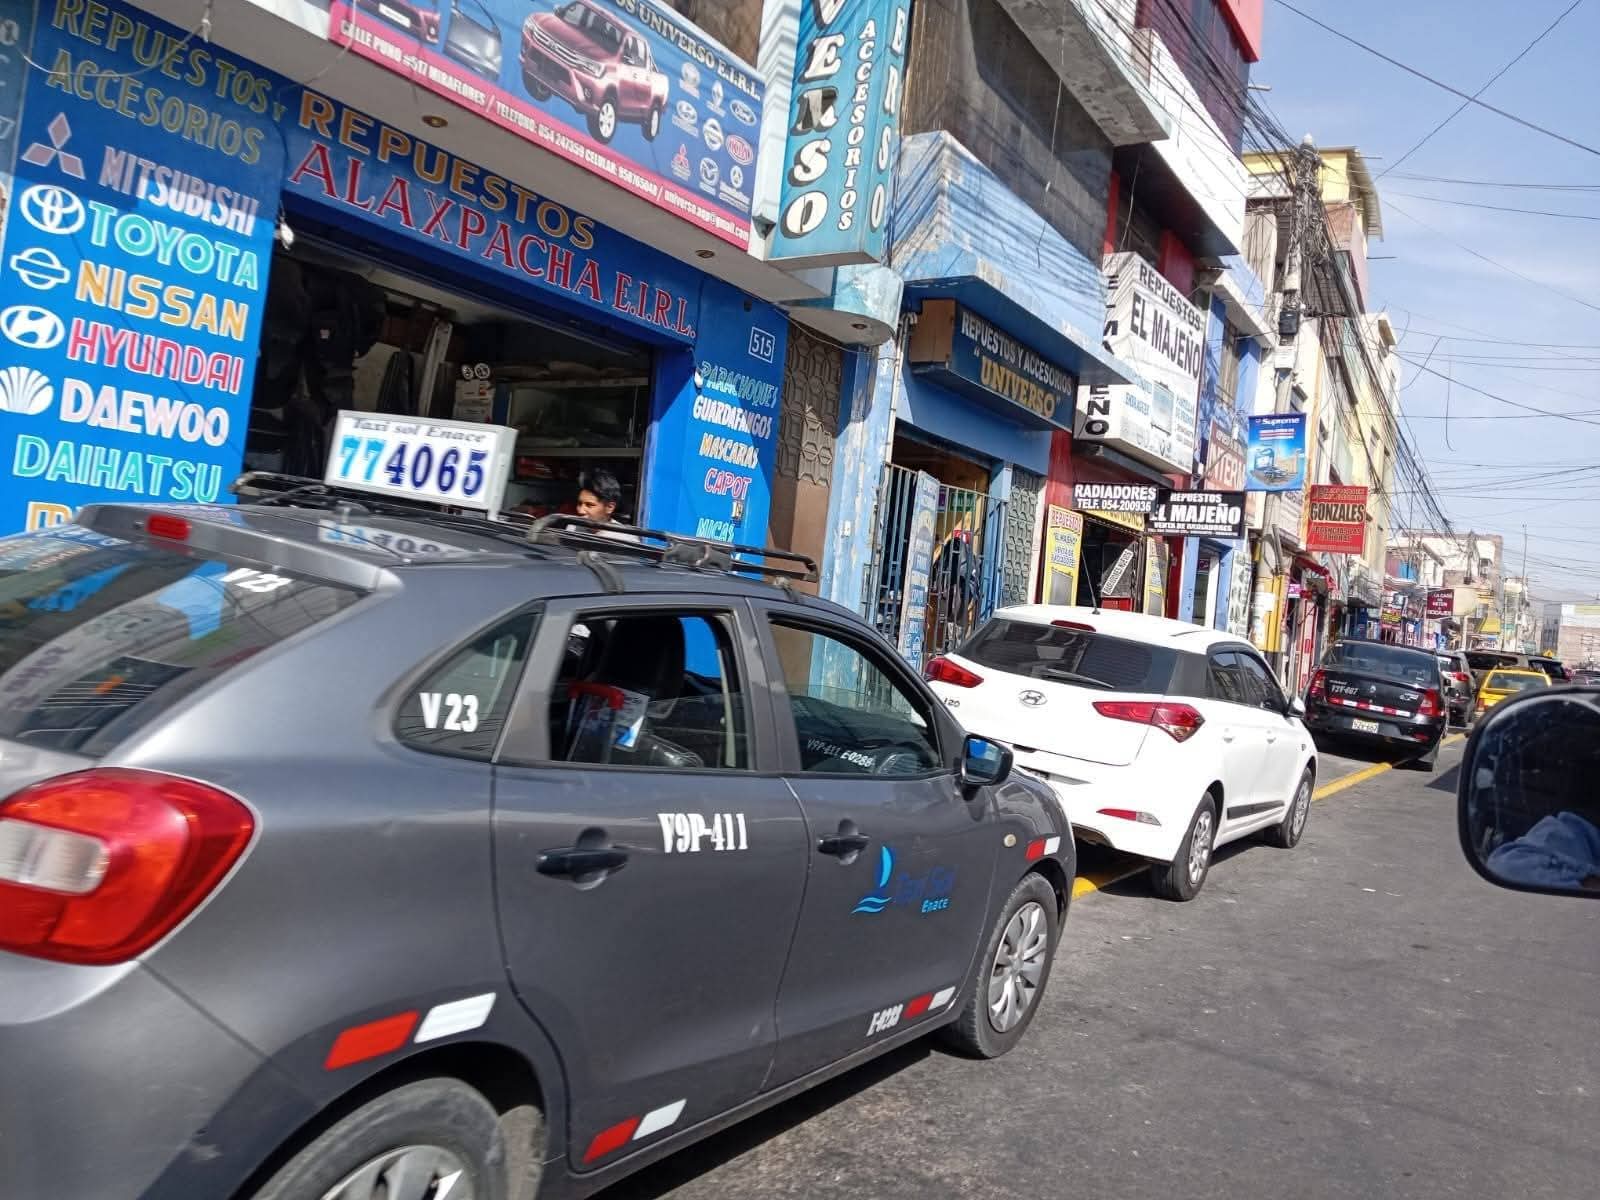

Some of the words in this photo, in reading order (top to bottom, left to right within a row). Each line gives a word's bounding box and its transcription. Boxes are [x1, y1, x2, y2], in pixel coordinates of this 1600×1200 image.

[52, 0, 272, 113] REPUESTOS
[640, 2, 716, 69] UNIVERSO
[46, 48, 265, 165] ACCESORIOS
[428, 65, 486, 106] MIRAFLORES
[838, 19, 878, 231] ACCESORIOS
[99, 146, 260, 237] MITSUBISHI
[299, 89, 595, 250] REPUESTOS
[89, 200, 259, 290] TOYOTA
[288, 140, 603, 303] ALAXPACHA
[613, 271, 696, 339] E.I.R.L.
[75, 260, 249, 341] NISSAN
[1139, 264, 1201, 331] REPUESTOS
[67, 318, 244, 395] HYUNDAI
[751, 332, 774, 358] 515
[961, 311, 1017, 365] REPUESTOS
[1017, 348, 1027, 368] Y
[1023, 356, 1073, 396] ACCESORIOS
[1130, 292, 1148, 341] EL
[1151, 308, 1201, 380] MAJEÑO
[60, 377, 229, 446] DAEWOO
[693, 395, 773, 439] GUARDAFANGOS
[700, 361, 778, 408] PARACHOQUES
[351, 417, 390, 430] Taxi
[699, 432, 758, 469] MASCARAS
[12, 434, 222, 504] DAIHATSU
[338, 434, 488, 497] 774065
[704, 467, 752, 499] CAPOT
[1074, 484, 1156, 500] RADIADORES
[1170, 493, 1222, 503] REPUESTOS
[696, 518, 736, 543] MICAS
[1077, 499, 1100, 510] TELF.
[1101, 500, 1151, 511] 054-200936
[1170, 503, 1241, 525] MAJEÑO
[1310, 502, 1366, 522] GONZALES
[656, 812, 748, 853] V9P-411
